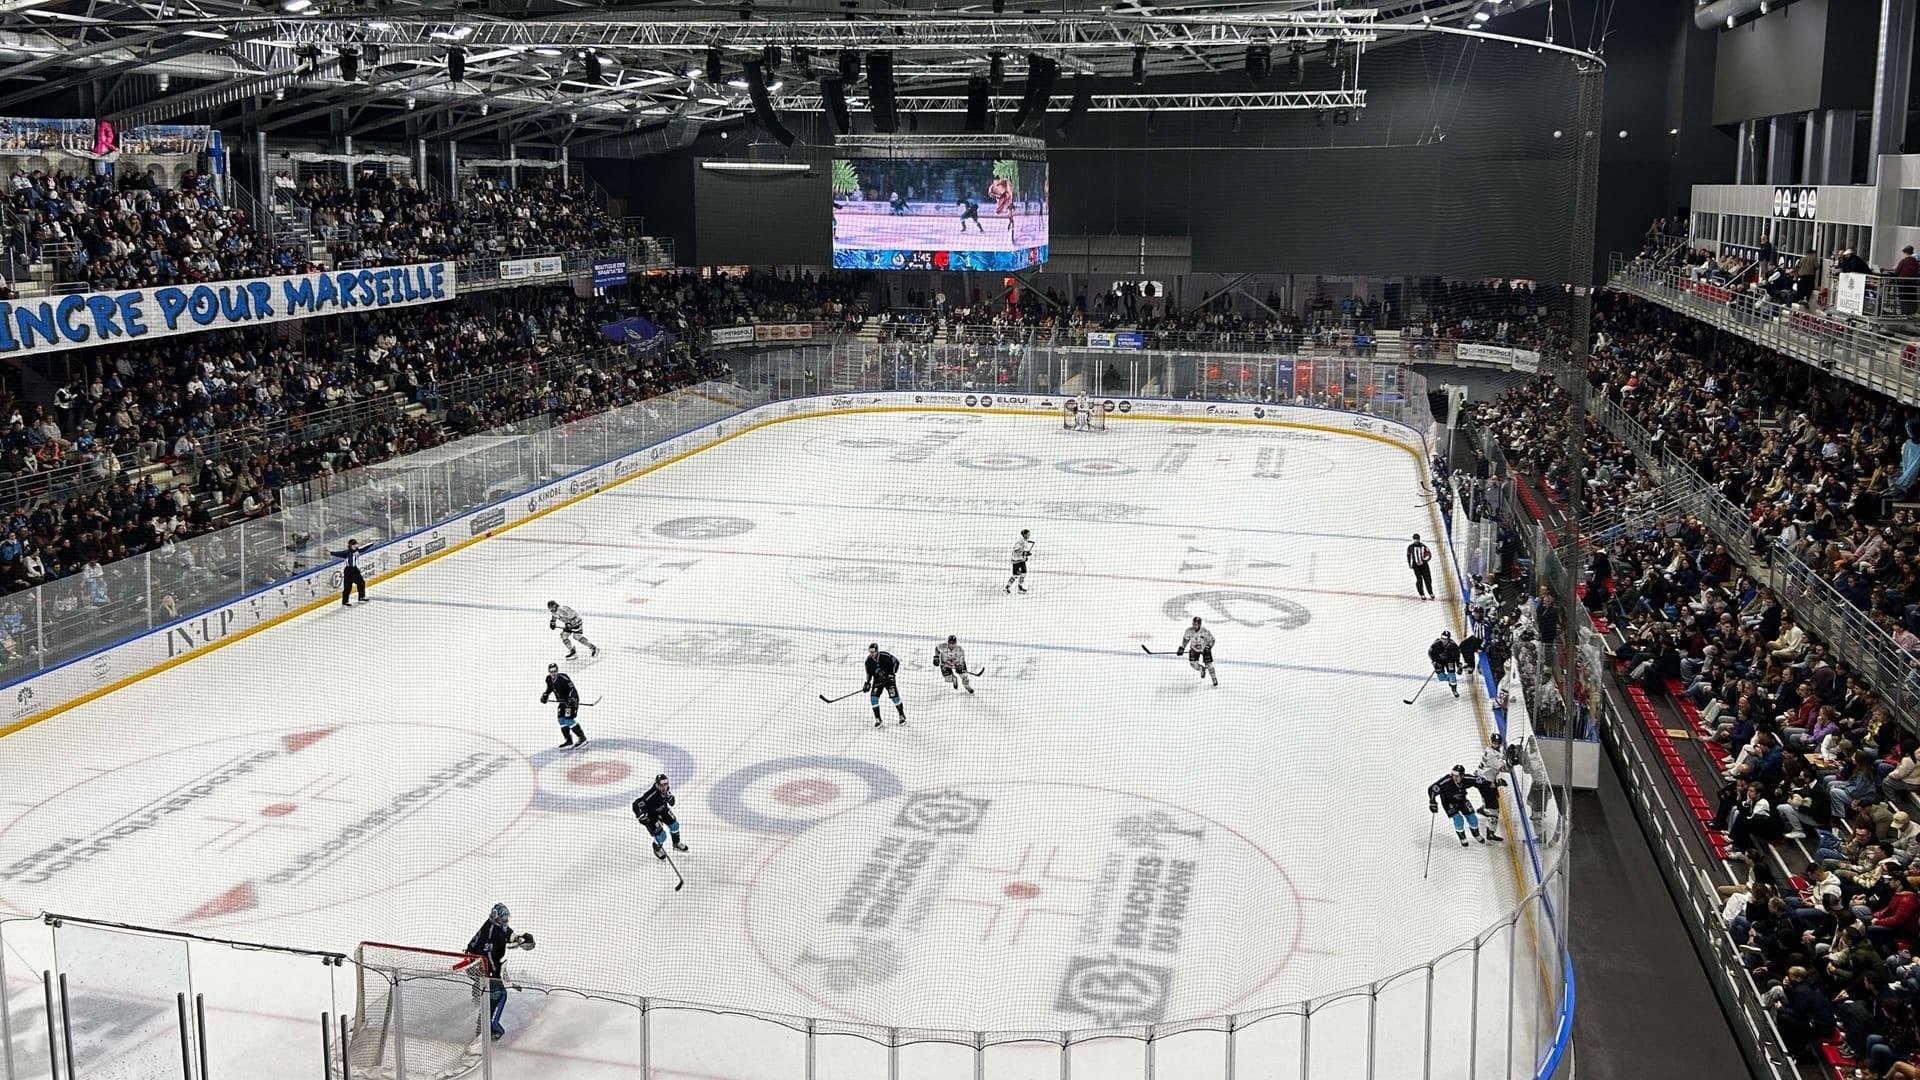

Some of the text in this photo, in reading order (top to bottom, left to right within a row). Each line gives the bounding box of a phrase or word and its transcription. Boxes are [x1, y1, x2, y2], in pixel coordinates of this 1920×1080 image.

[155, 281, 274, 329] POUR
[284, 263, 445, 315] MARSEILLE
[872, 836, 905, 863] DU
[862, 838, 937, 928] BOUCHES
[1114, 854, 1165, 948] BOUCHES
[1150, 922, 1181, 953] DU
